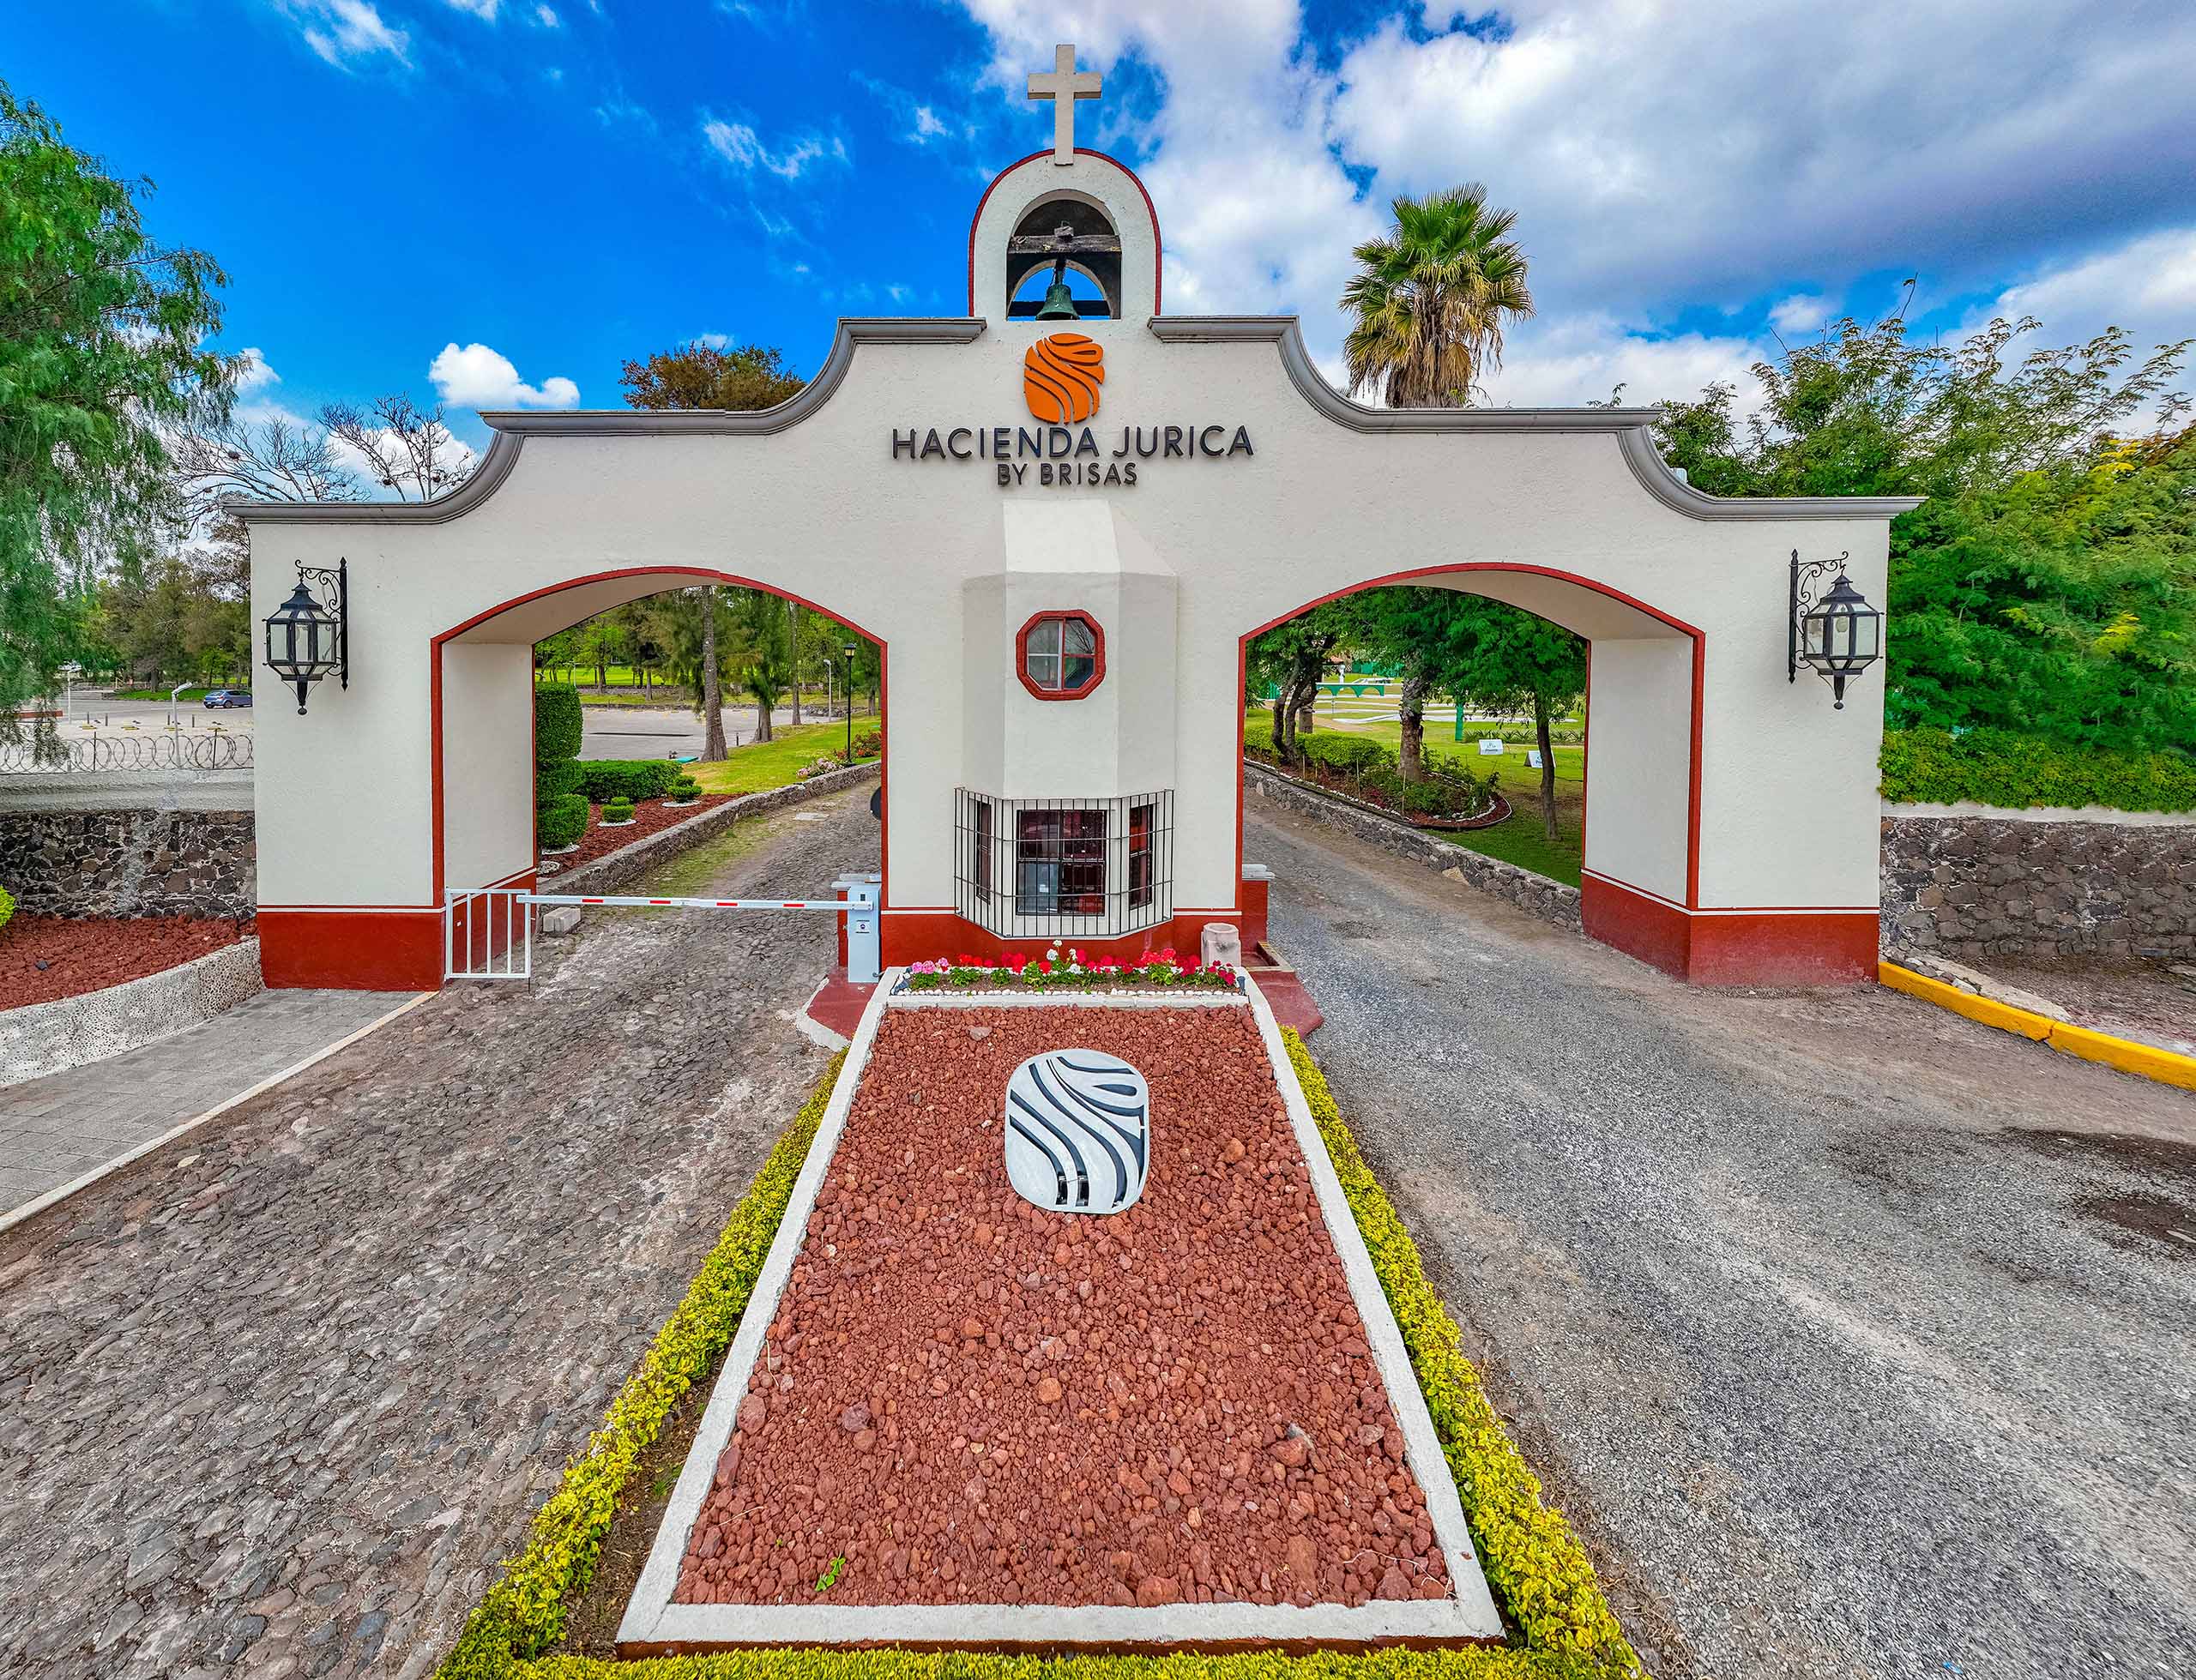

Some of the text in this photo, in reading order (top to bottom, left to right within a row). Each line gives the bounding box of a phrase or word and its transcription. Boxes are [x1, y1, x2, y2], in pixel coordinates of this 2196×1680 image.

[892, 425, 1254, 459] HACIENDA JURICA
[997, 462, 1137, 486] BY BRISAS
